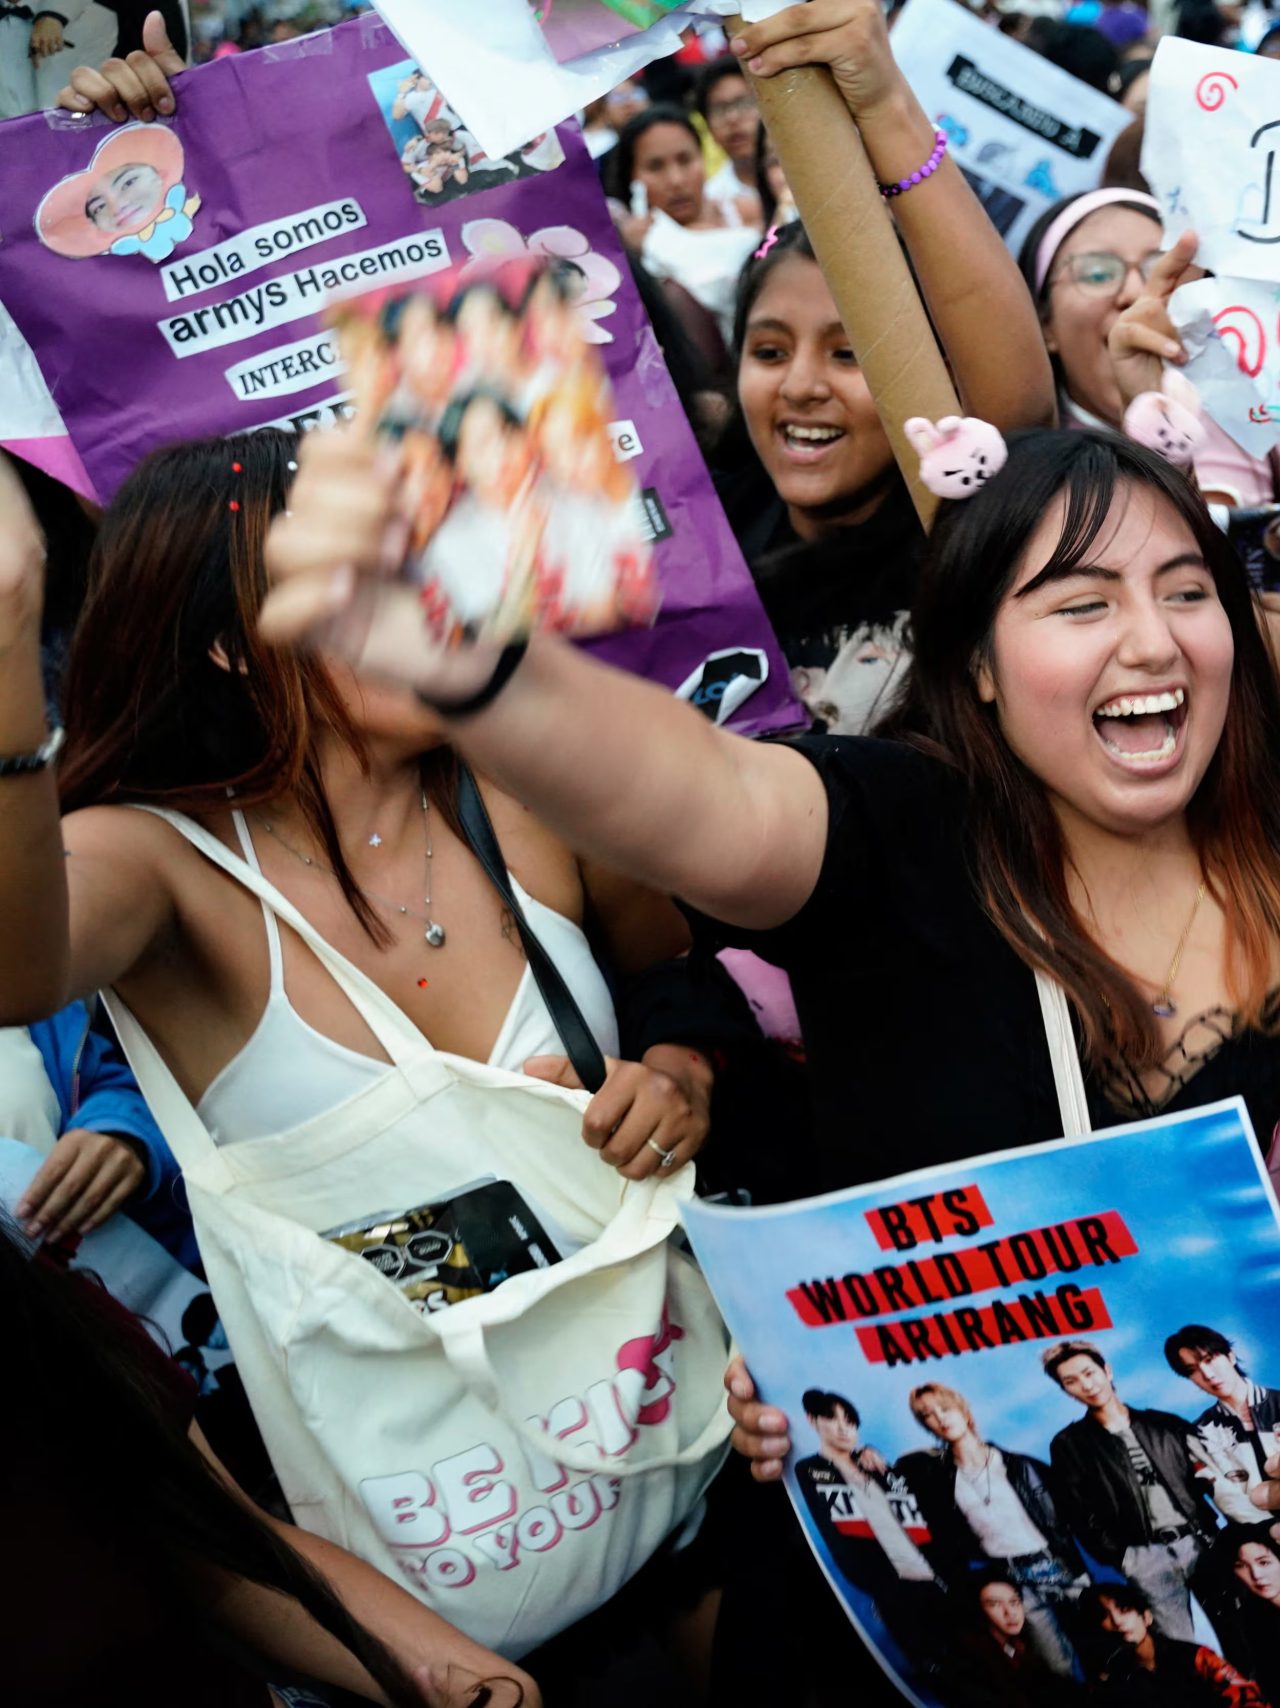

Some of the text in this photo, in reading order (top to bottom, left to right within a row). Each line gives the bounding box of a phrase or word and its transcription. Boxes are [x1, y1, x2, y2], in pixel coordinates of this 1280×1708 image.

[168, 202, 360, 296] Hola somos
[168, 237, 443, 344] armys Hacemos
[877, 1187, 981, 1252] BTS
[798, 1216, 1121, 1325] WORLD TOUR
[873, 1282, 1096, 1368] ARIRANG
[359, 1442, 519, 1549] BE
